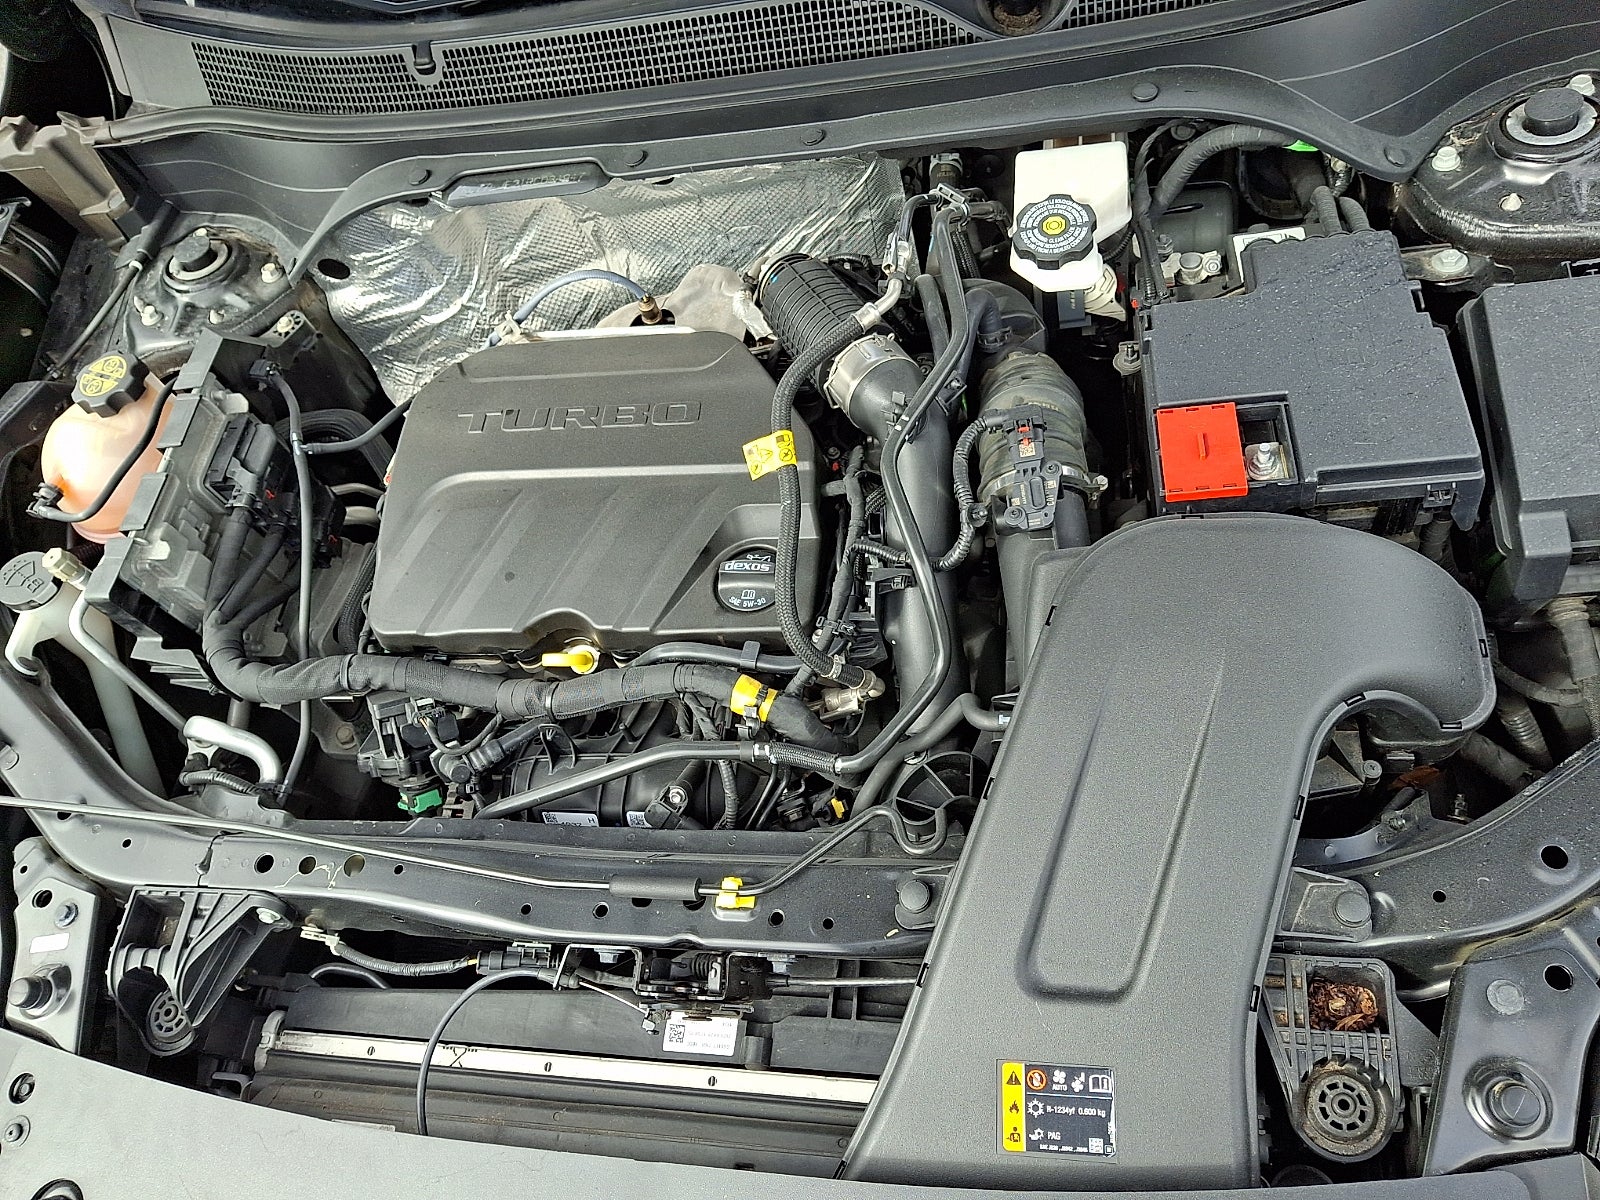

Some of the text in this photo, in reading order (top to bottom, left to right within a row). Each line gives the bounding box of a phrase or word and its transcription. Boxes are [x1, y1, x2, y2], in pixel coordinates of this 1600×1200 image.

[457, 402, 702, 434] TURBO
[724, 561, 772, 572] dexos
[728, 597, 766, 607] SAE 5W-30
[1046, 1105, 1075, 1116] R-1234yf
[1097, 1109, 1106, 1118] kg
[1047, 1131, 1061, 1141] PAG
